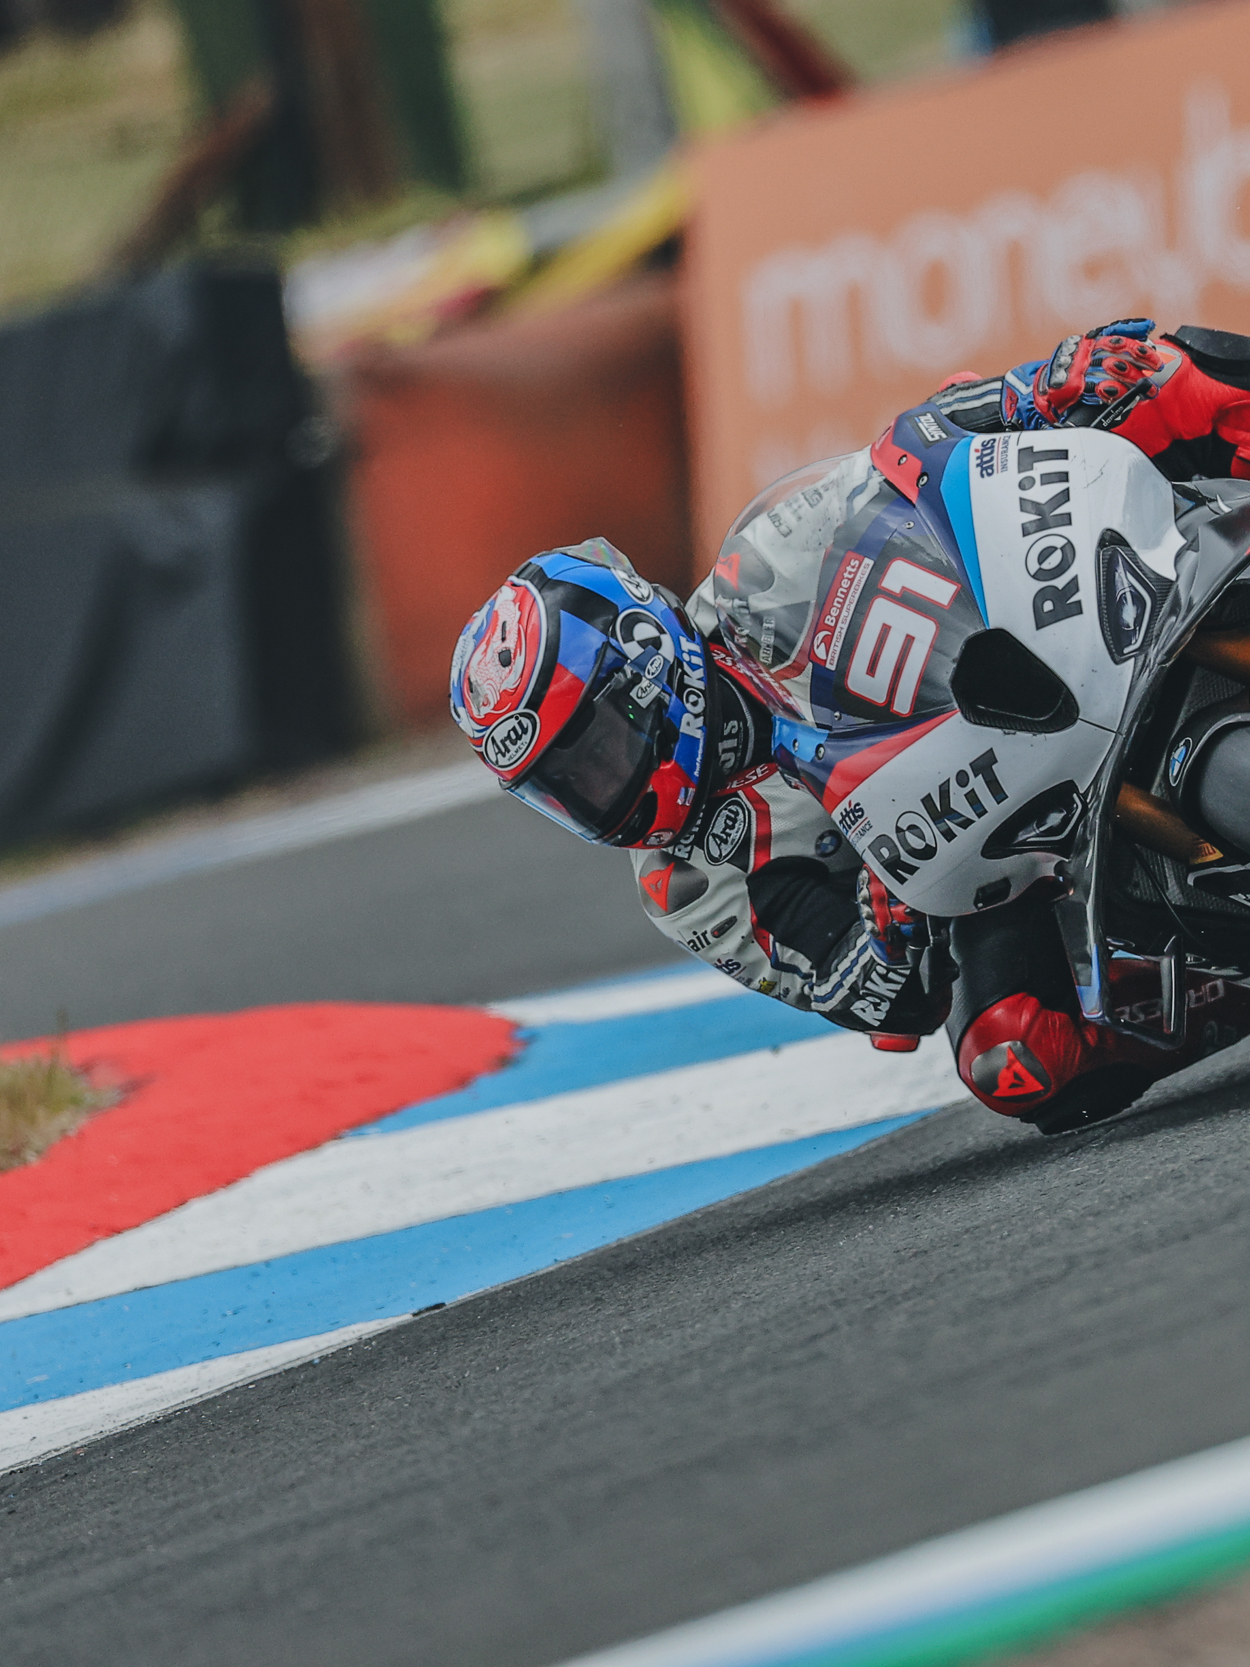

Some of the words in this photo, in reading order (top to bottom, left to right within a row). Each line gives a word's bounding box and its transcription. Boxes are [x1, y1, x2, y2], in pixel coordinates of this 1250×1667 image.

[914, 412, 948, 442] SYNTOL
[1102, 406, 1124, 427] domino
[974, 437, 997, 479] attis
[1000, 434, 1011, 473] INSURANCE
[1017, 445, 1084, 631] ROKiT
[824, 558, 860, 628] Bennetts
[828, 627, 845, 666] BRITISH
[840, 562, 870, 625] SUPERBIKES
[844, 557, 961, 718] 91
[644, 656, 664, 679] Arai
[679, 635, 706, 739] ROKiT
[491, 714, 529, 767] Arai
[709, 805, 740, 861] Arai
[867, 747, 1010, 886] ROKiT
